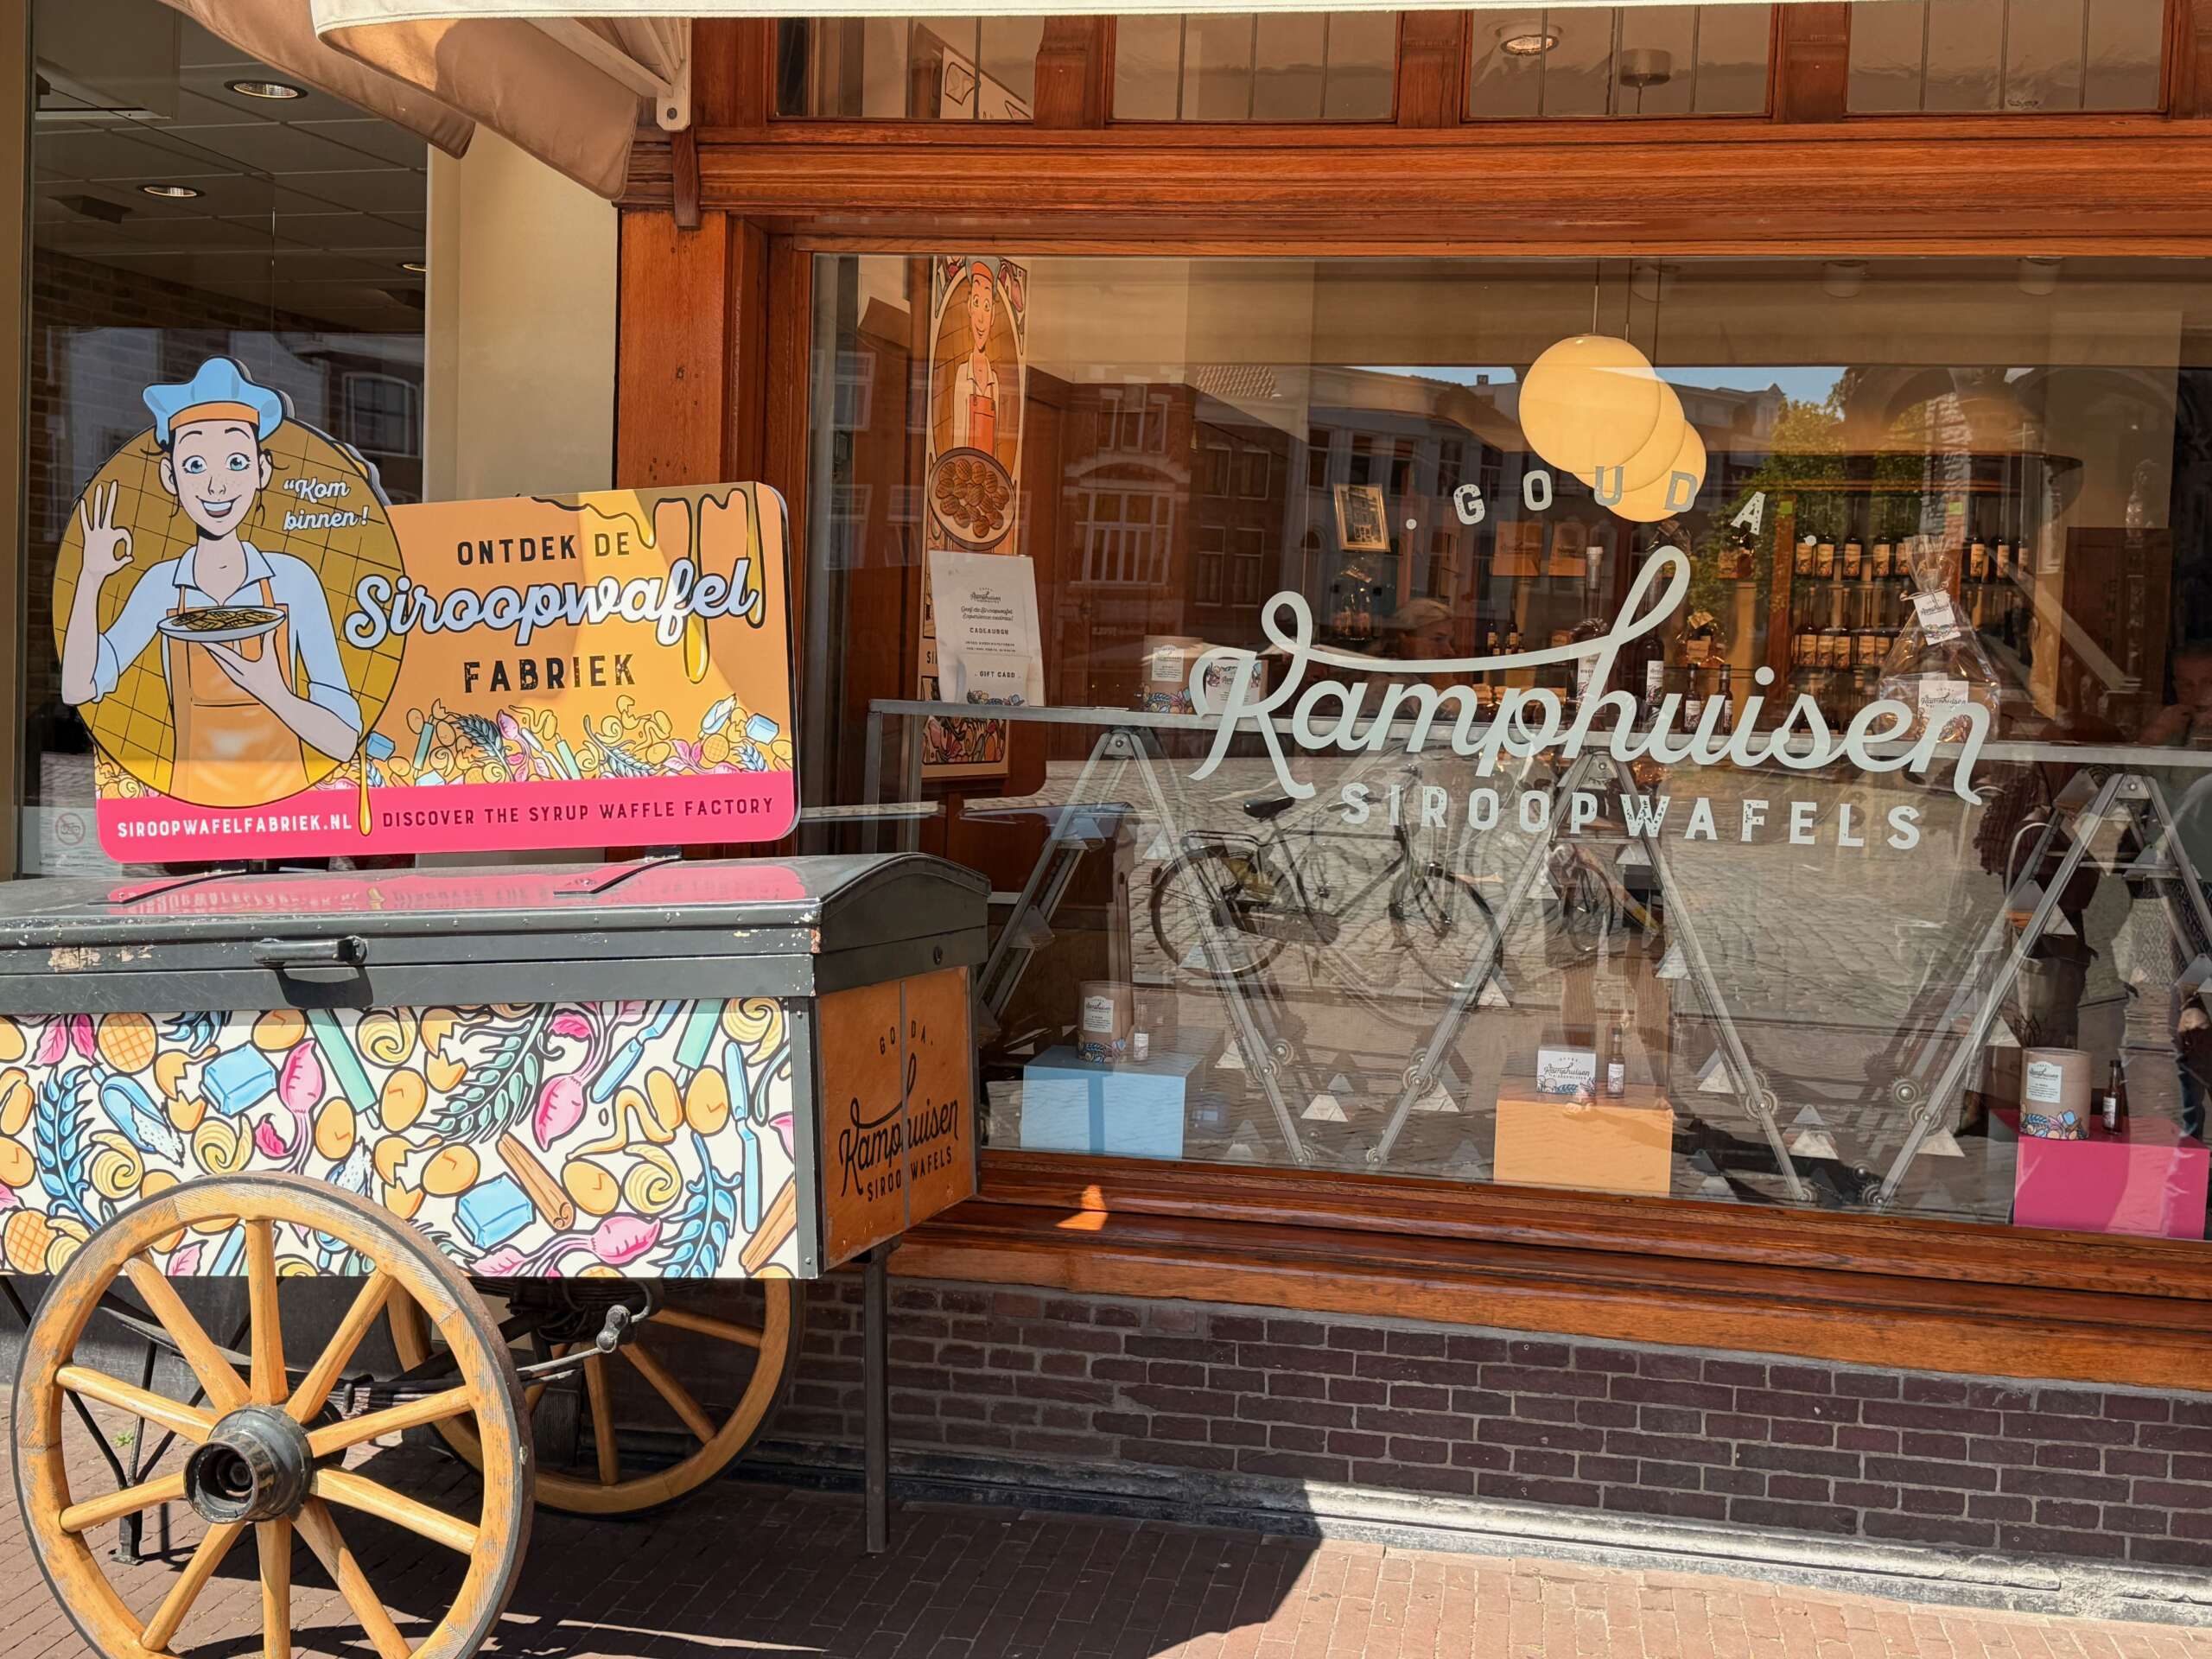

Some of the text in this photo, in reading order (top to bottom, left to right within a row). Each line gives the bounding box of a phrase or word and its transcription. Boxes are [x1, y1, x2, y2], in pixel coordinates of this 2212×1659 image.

[1452, 465, 1765, 537] GOUDA
[457, 531, 630, 565] ONTDEK DE
[345, 557, 759, 649] Siroopwafel
[463, 653, 636, 693] FABRIEK
[1190, 545, 1993, 805] Kamphuisen
[117, 814, 353, 837] SIROOPWAFELFABRIEK.NL
[383, 798, 774, 828] DISCOVER THE SYRUP WAFFLE FACTORY
[1340, 783, 1921, 850] SIROOPWAFELS
[880, 1020, 926, 1055] GODA
[867, 1146, 953, 1202] SIROOWAFELS
